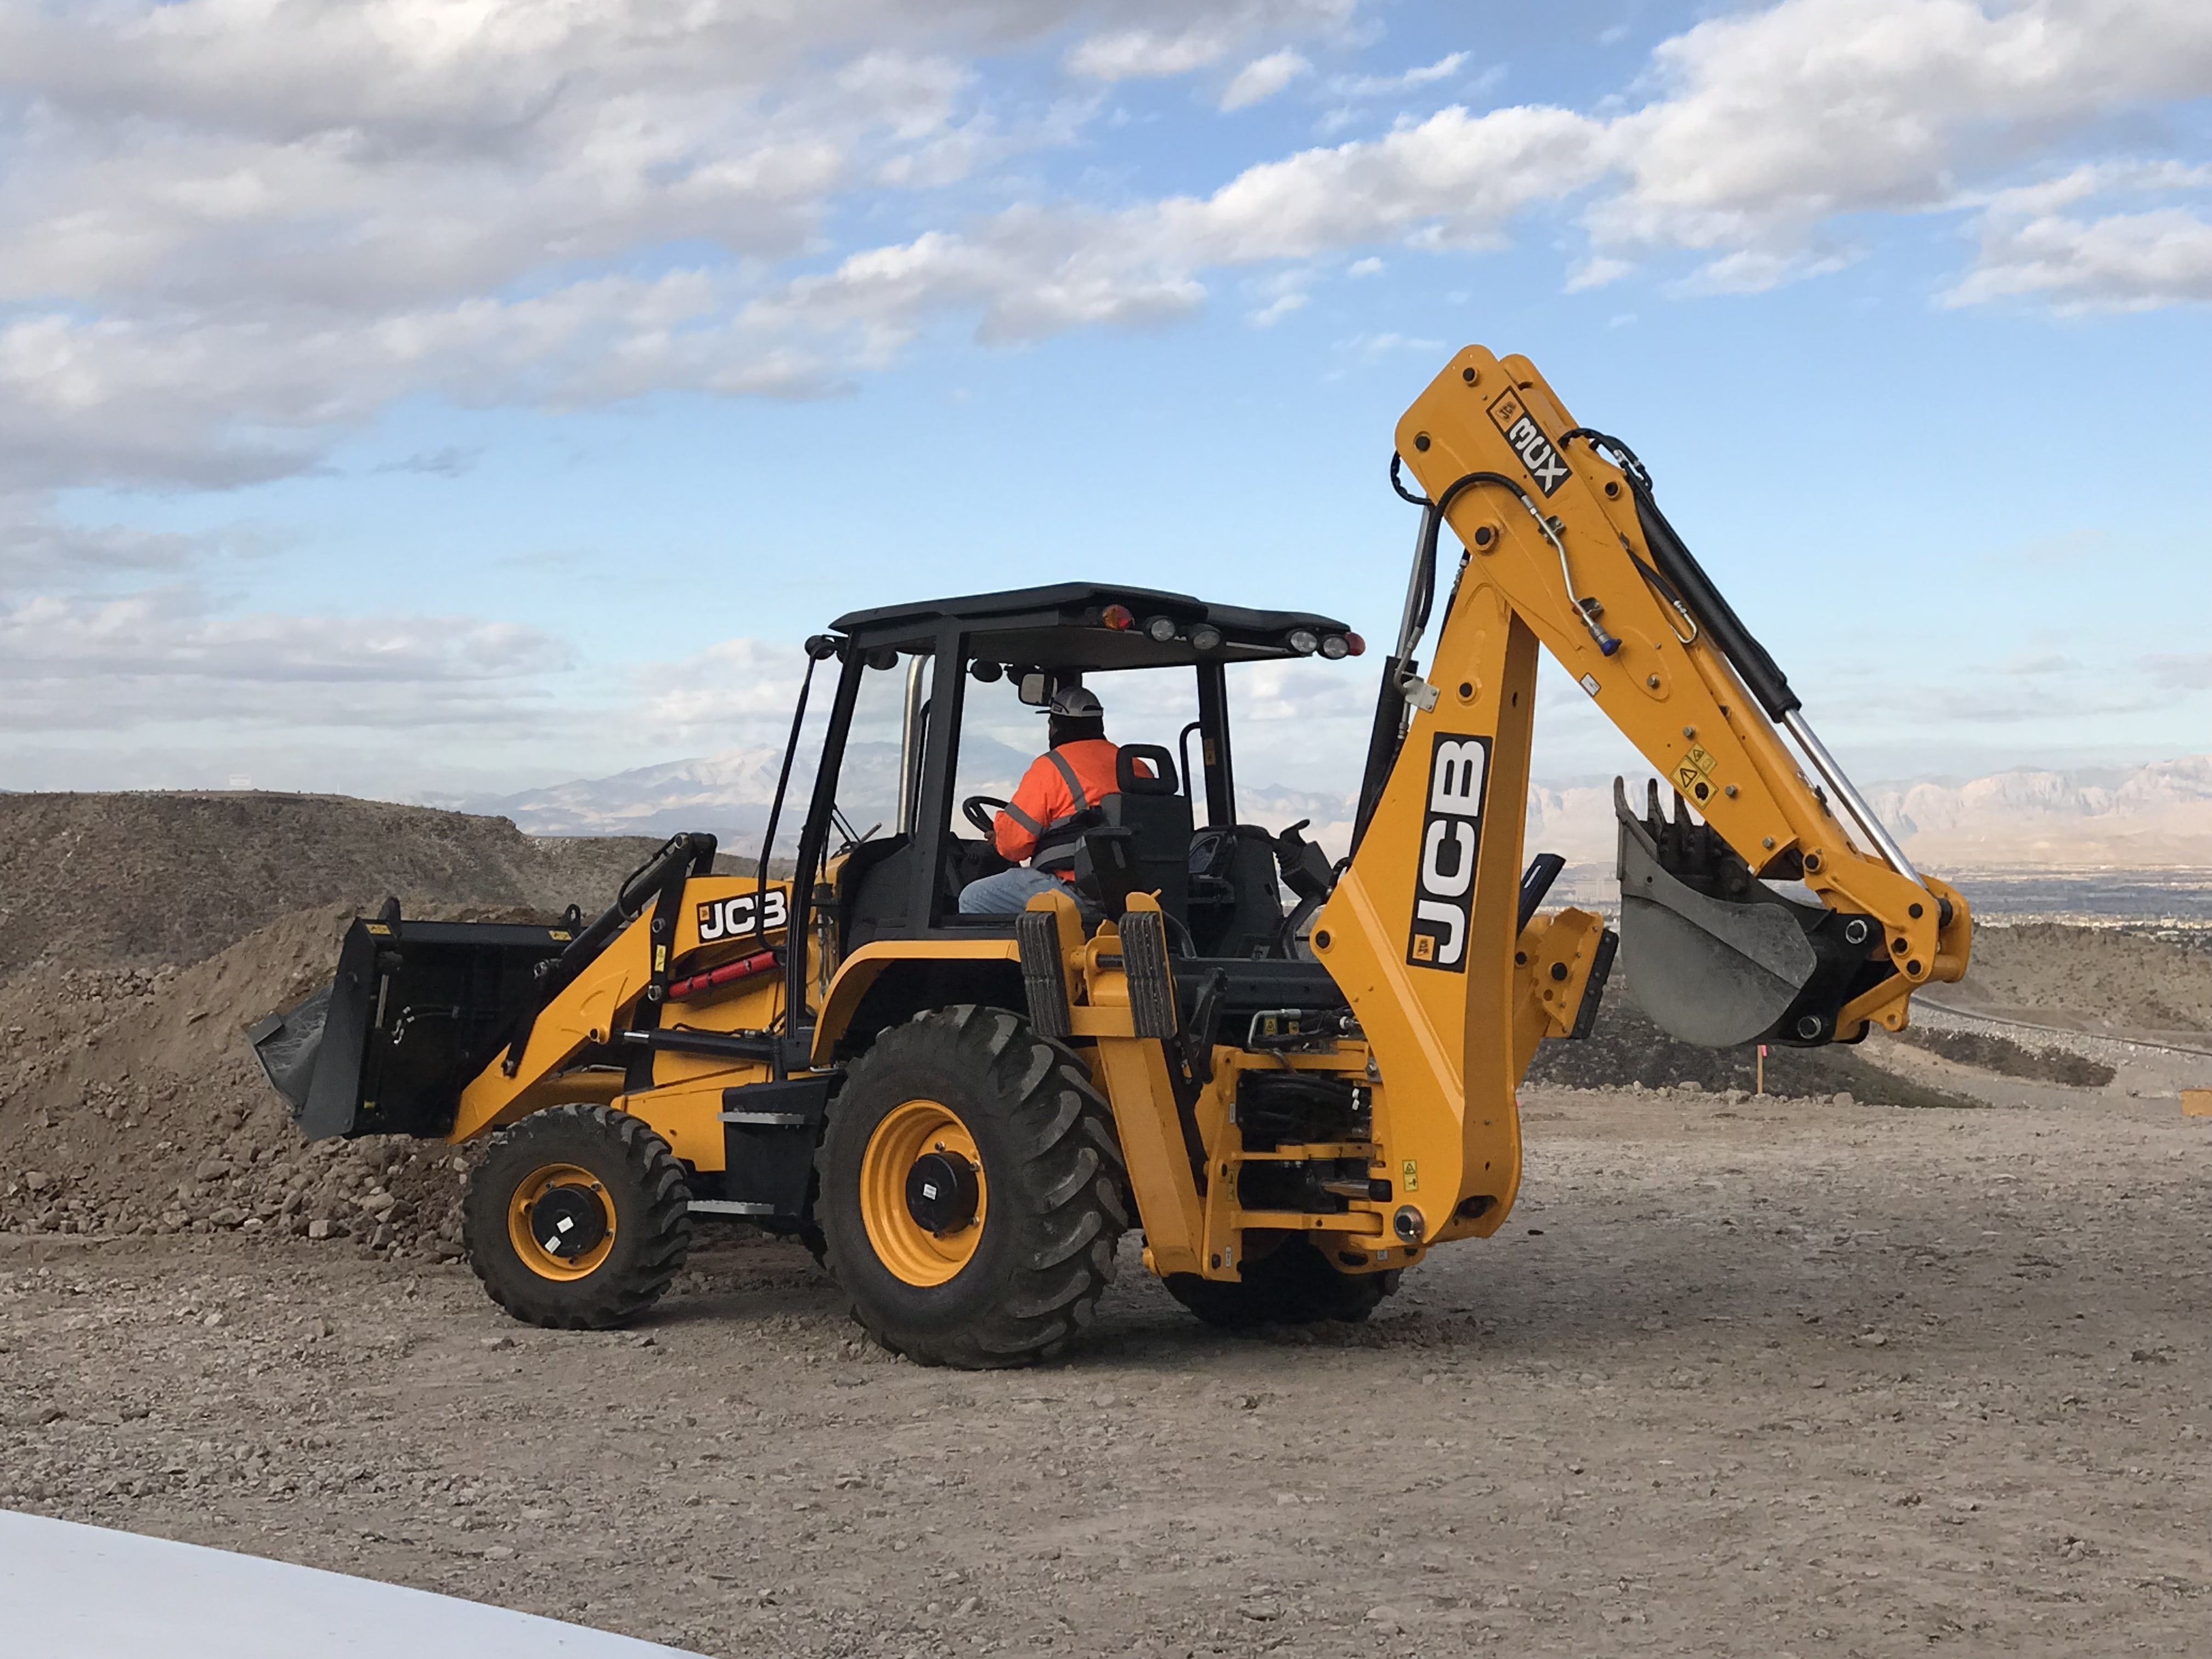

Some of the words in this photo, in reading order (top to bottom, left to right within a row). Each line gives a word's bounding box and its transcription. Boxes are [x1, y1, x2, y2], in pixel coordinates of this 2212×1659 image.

[1499, 401, 1516, 420] JCB
[1510, 417, 1568, 493] 3CX
[1417, 741, 1485, 964] JCB
[701, 891, 787, 939] JCB
